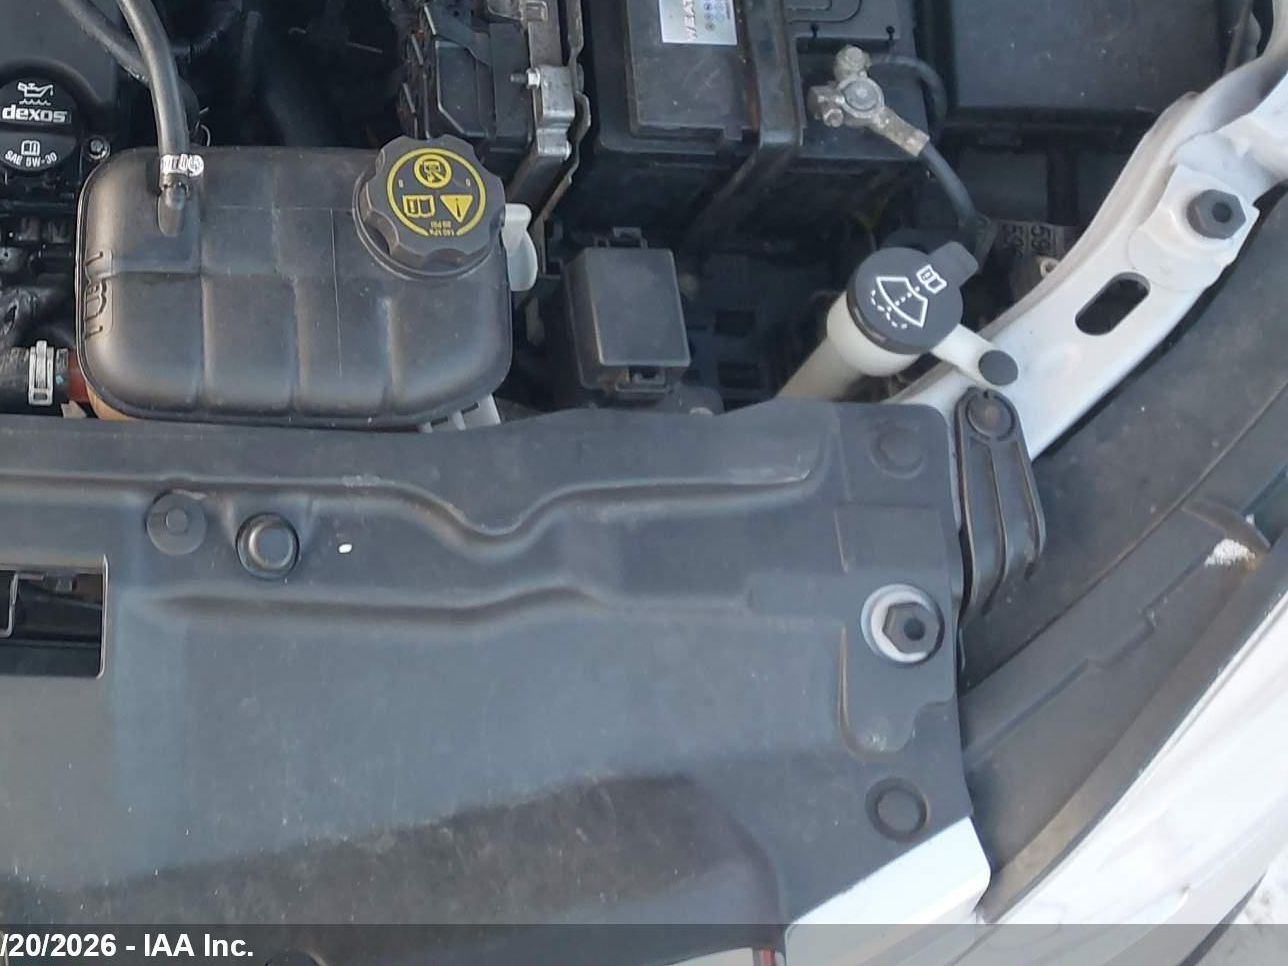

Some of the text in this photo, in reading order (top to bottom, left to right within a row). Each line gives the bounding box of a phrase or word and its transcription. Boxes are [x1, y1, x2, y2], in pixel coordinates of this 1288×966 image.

[2, 104, 68, 123] dexos
[5, 150, 58, 167] SAE 5W-30
